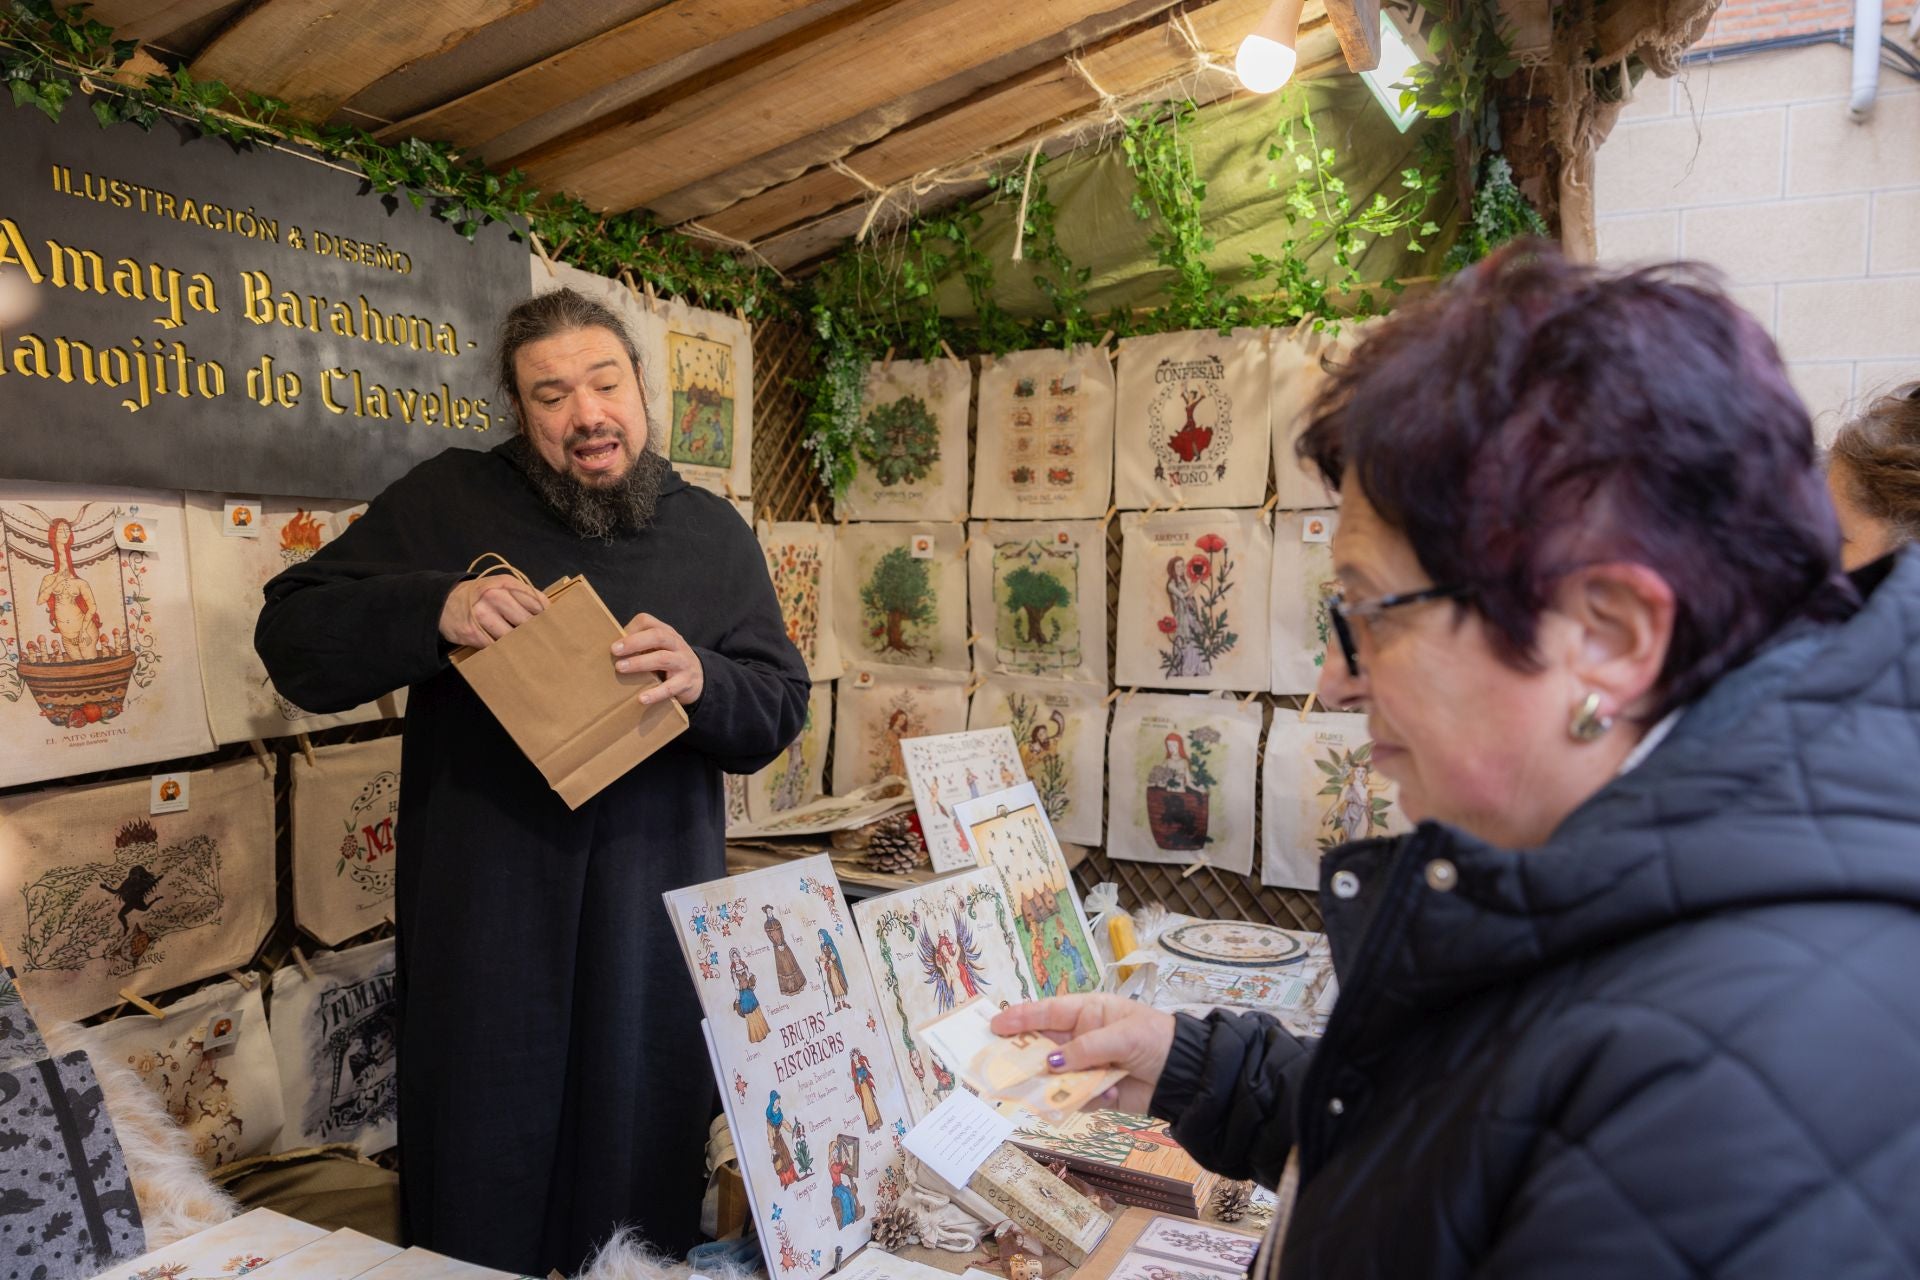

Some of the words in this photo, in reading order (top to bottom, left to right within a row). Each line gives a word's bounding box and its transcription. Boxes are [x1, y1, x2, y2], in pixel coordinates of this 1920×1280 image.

[52, 164, 279, 244] ILUSTRACIÓN
[287, 226, 306, 250] &
[313, 230, 413, 275] DISEÑO
[0, 217, 220, 329] Amaya
[0, 331, 225, 412] anojito
[246, 354, 302, 408] de
[1155, 364, 1225, 384] CONFESAR
[779, 1011, 826, 1048] BRUJAS
